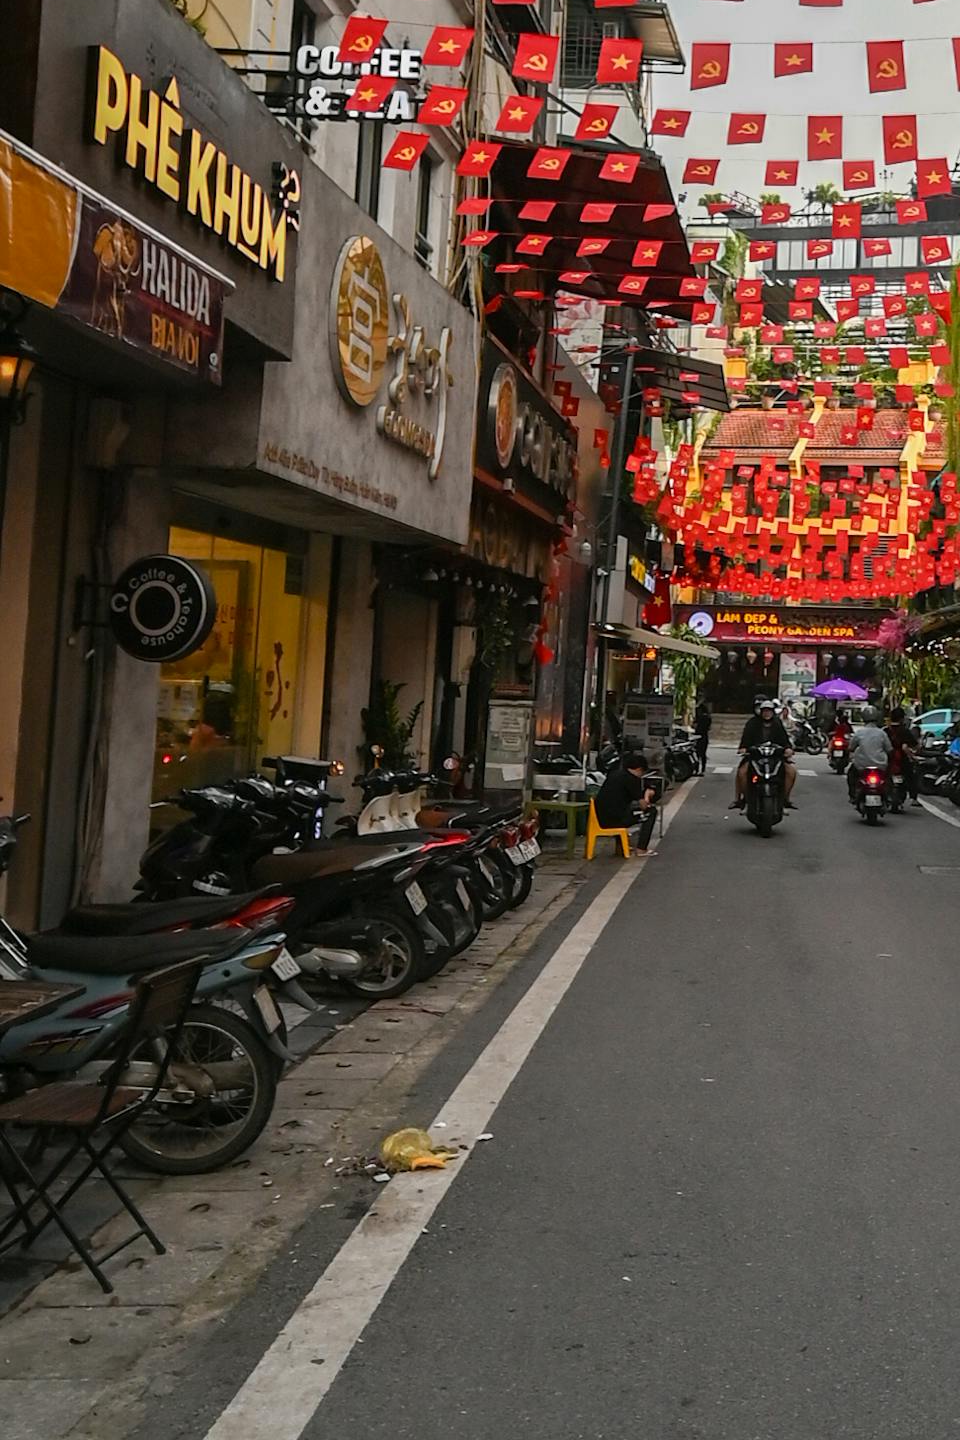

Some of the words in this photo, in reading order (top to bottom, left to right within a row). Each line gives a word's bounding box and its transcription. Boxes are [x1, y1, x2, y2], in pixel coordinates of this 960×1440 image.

[296, 44, 421, 78] COEE
[305, 86, 331, 116] &
[94, 44, 184, 202] PHÊ
[141, 237, 211, 327] HALIDA
[128, 567, 176, 590] Coffee
[141, 596, 193, 646] Teahouse
[832, 627, 854, 637] SPA
